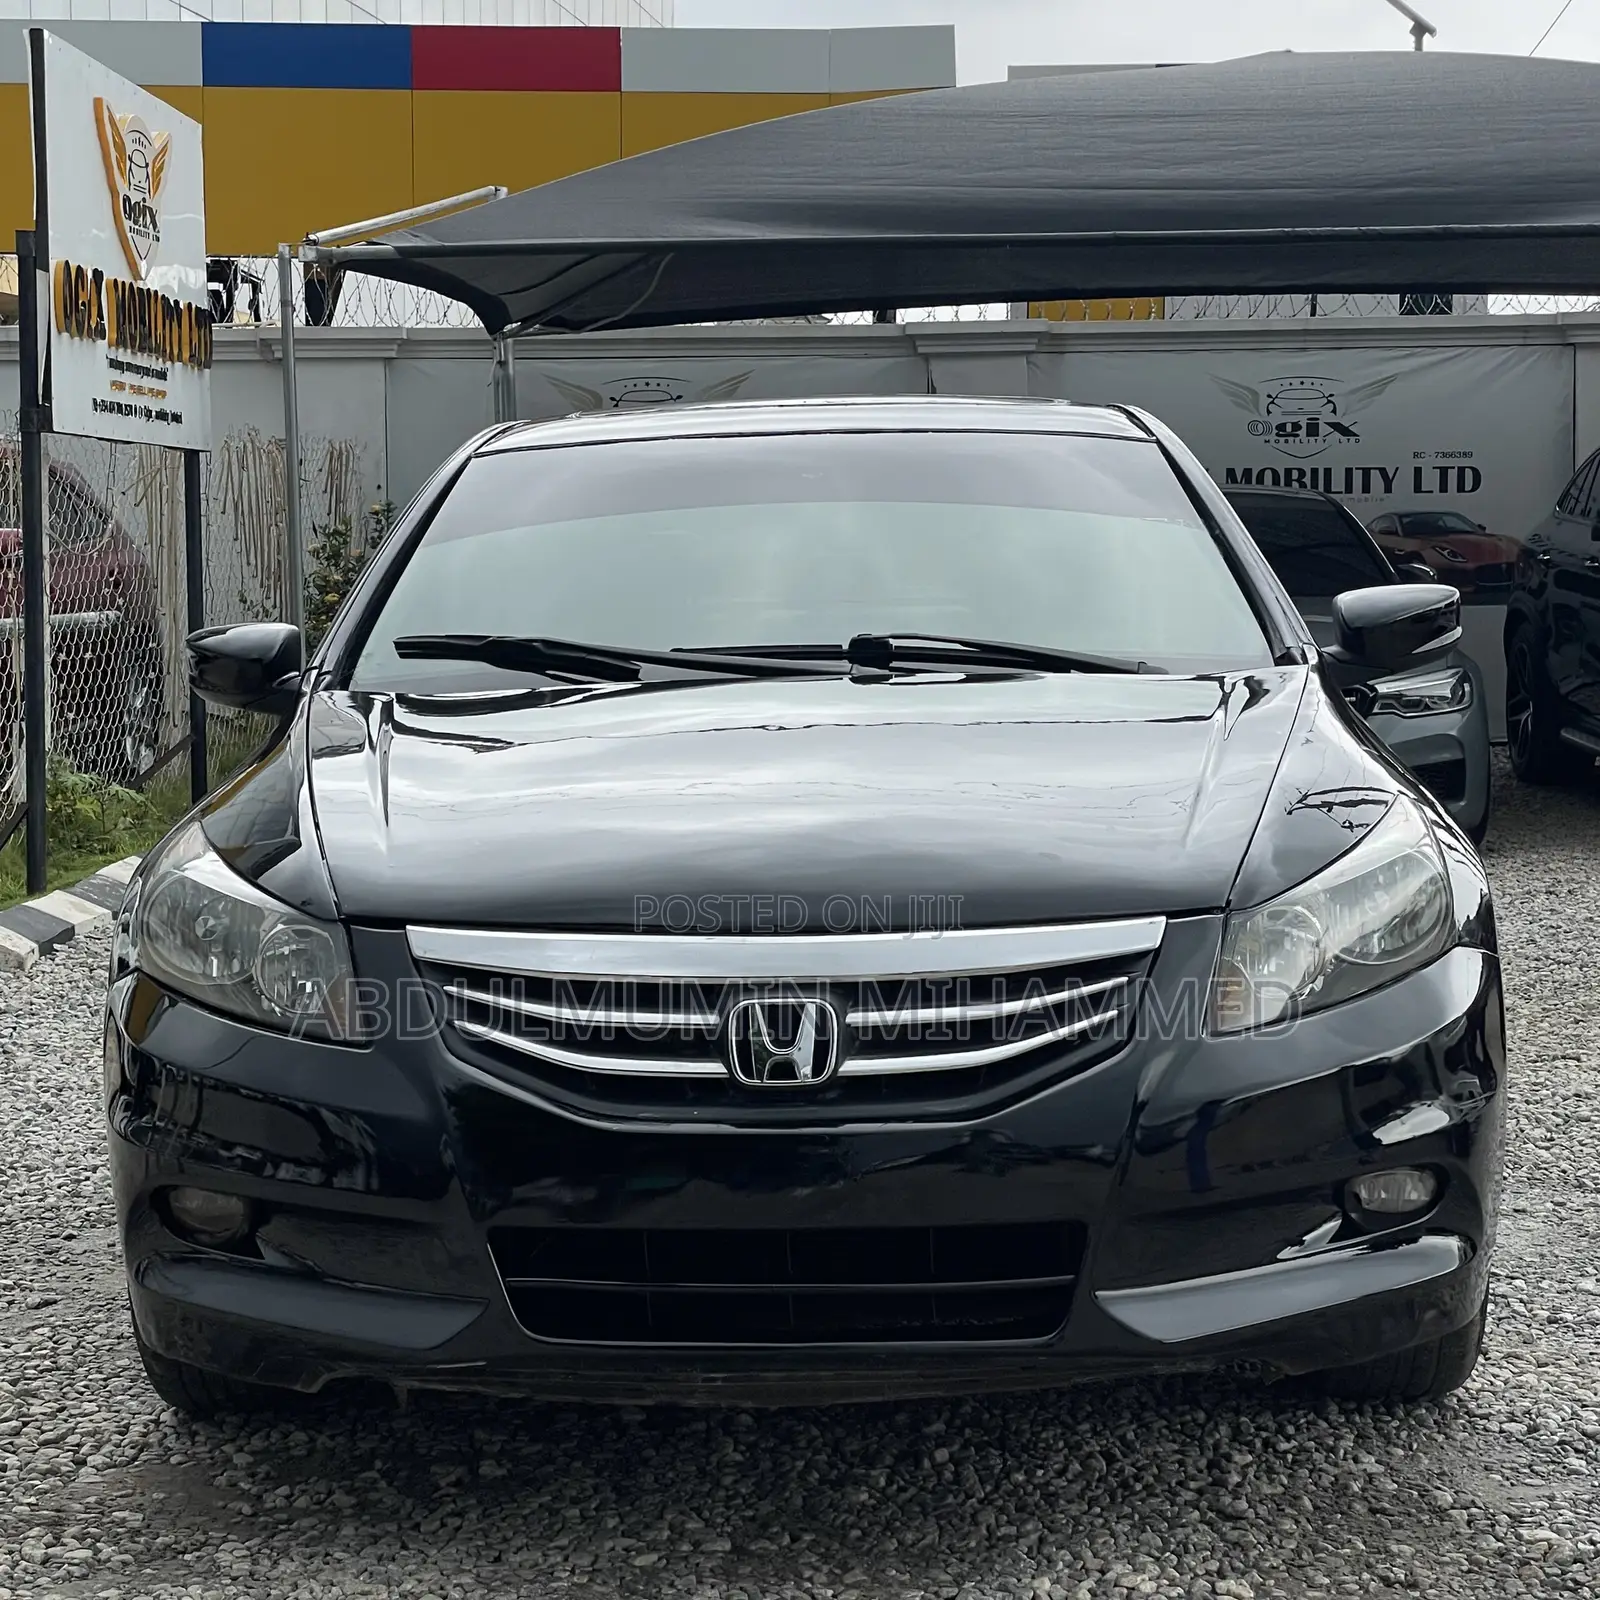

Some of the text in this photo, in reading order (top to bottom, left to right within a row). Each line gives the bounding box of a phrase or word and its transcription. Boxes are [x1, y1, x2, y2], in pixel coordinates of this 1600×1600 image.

[1413, 451, 1426, 459] RC
[1434, 450, 1473, 459] 7366389
[1225, 466, 1482, 494] MOBILITY LTD
